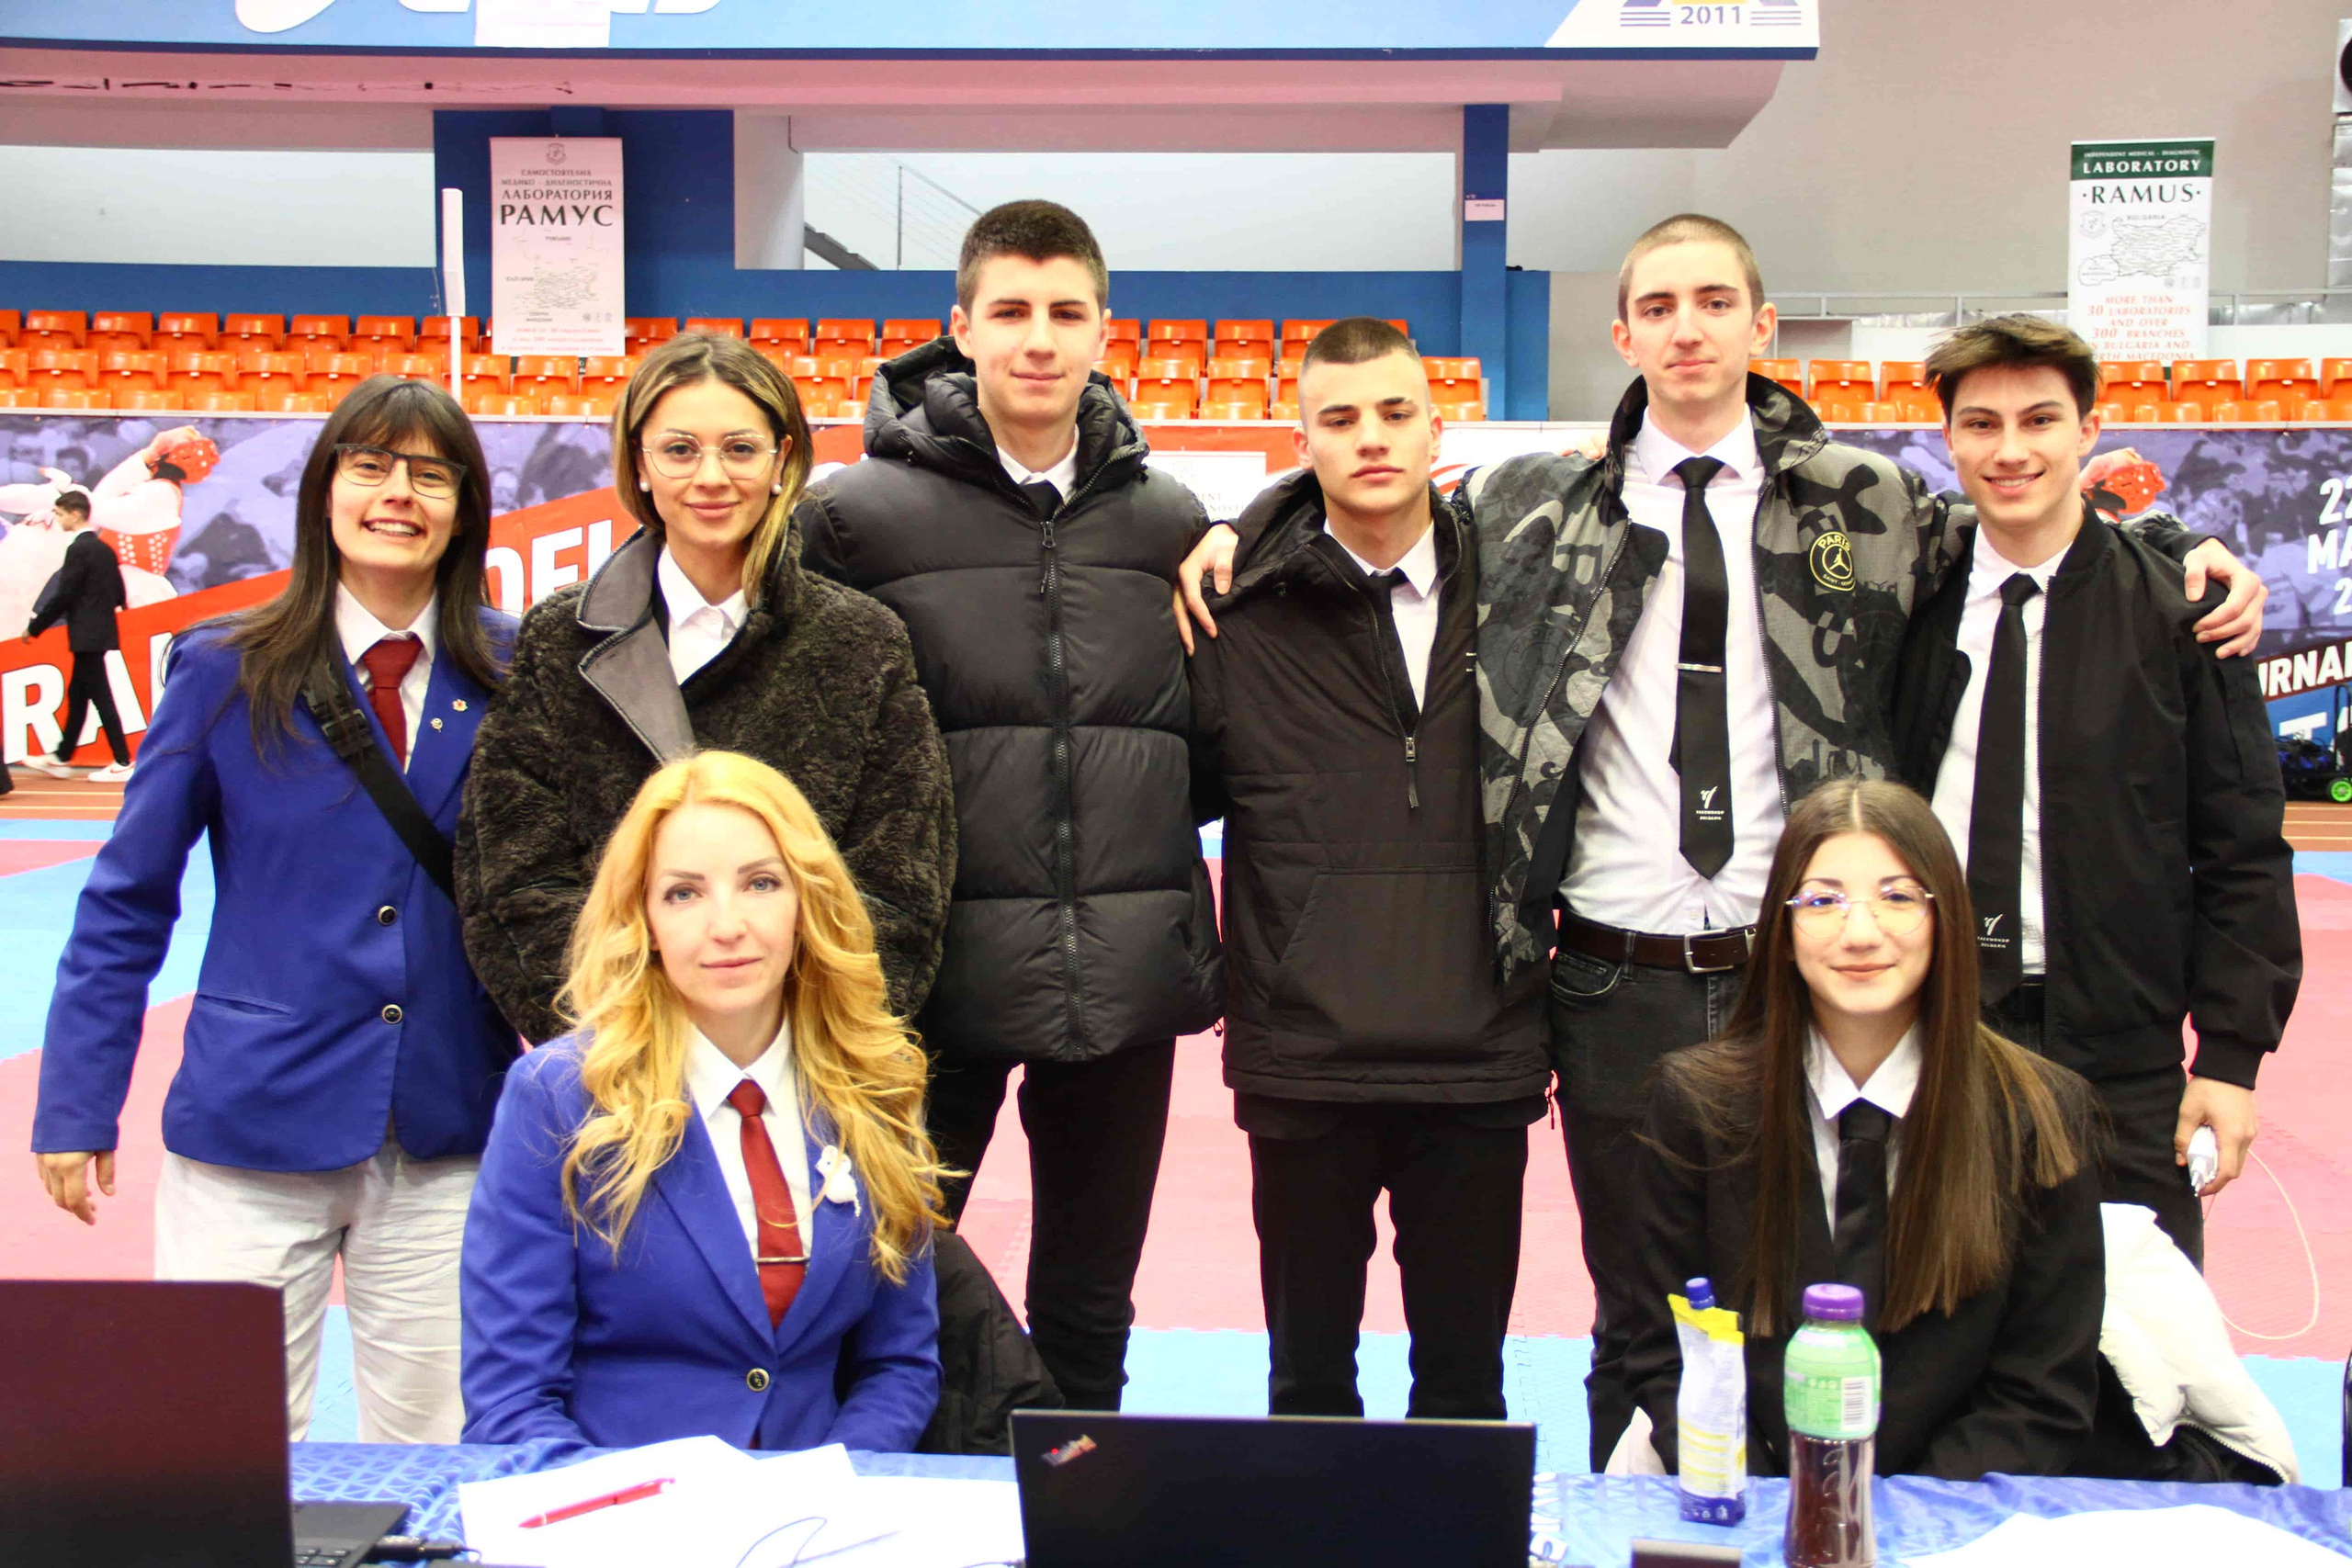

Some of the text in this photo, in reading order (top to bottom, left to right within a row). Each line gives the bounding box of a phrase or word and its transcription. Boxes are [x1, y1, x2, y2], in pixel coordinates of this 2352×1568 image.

[1680, 6, 1741, 25] 2011
[2083, 159, 2201, 175] LABORATORY
[502, 188, 613, 200] ЛАБОРАТОРИЯ
[501, 204, 614, 227] РАМУС
[2105, 295, 2173, 304] MORE THAN
[2086, 305, 2191, 316] 30 LABORATORIES
[2109, 318, 2169, 326] AND OVER
[2092, 328, 2186, 339] 300 BRANCHES
[2103, 341, 2160, 350] BULGARIA
[2165, 341, 2190, 349] AND
[2126, 352, 2196, 361] MACEDONIA
[1817, 535, 1851, 551] PARIS
